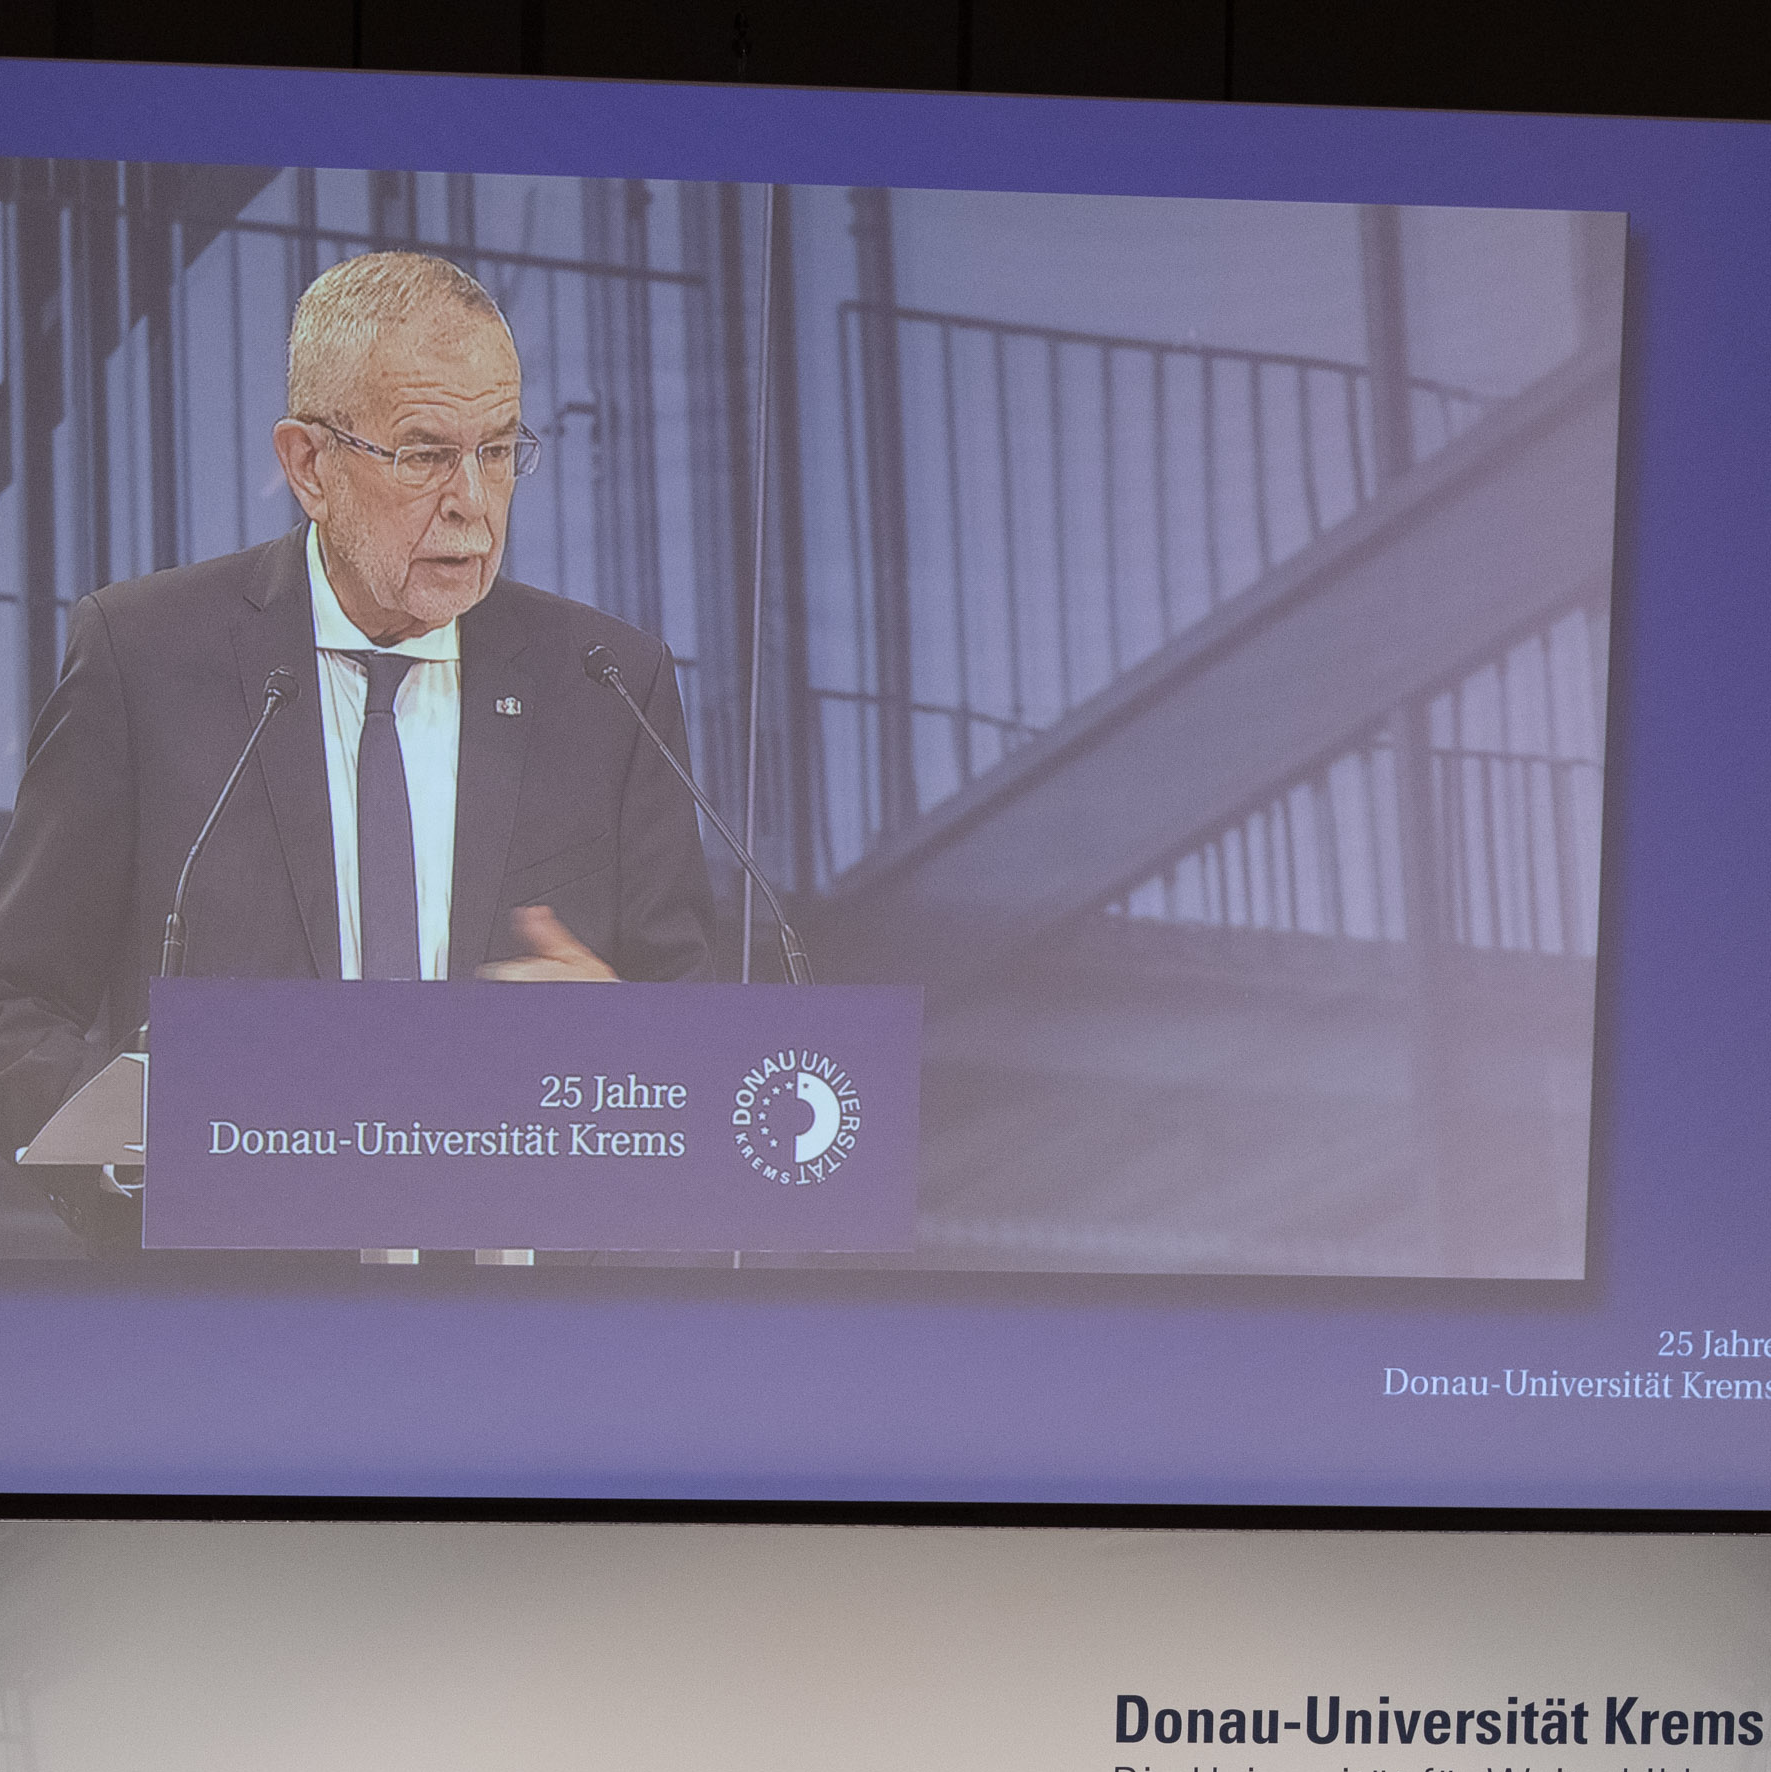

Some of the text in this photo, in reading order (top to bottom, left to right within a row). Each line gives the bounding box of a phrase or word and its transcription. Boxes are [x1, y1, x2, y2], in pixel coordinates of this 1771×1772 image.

[540, 1074, 687, 1113] 25 Jahre
[209, 1121, 685, 1157] Donau-Universität Krems
[735, 1132, 791, 1185] KREMS
[1658, 1330, 1694, 1357] 25
[1384, 1367, 1672, 1399] Donau-Universität
[1115, 1694, 1764, 1746] Donau-Universität Krems
